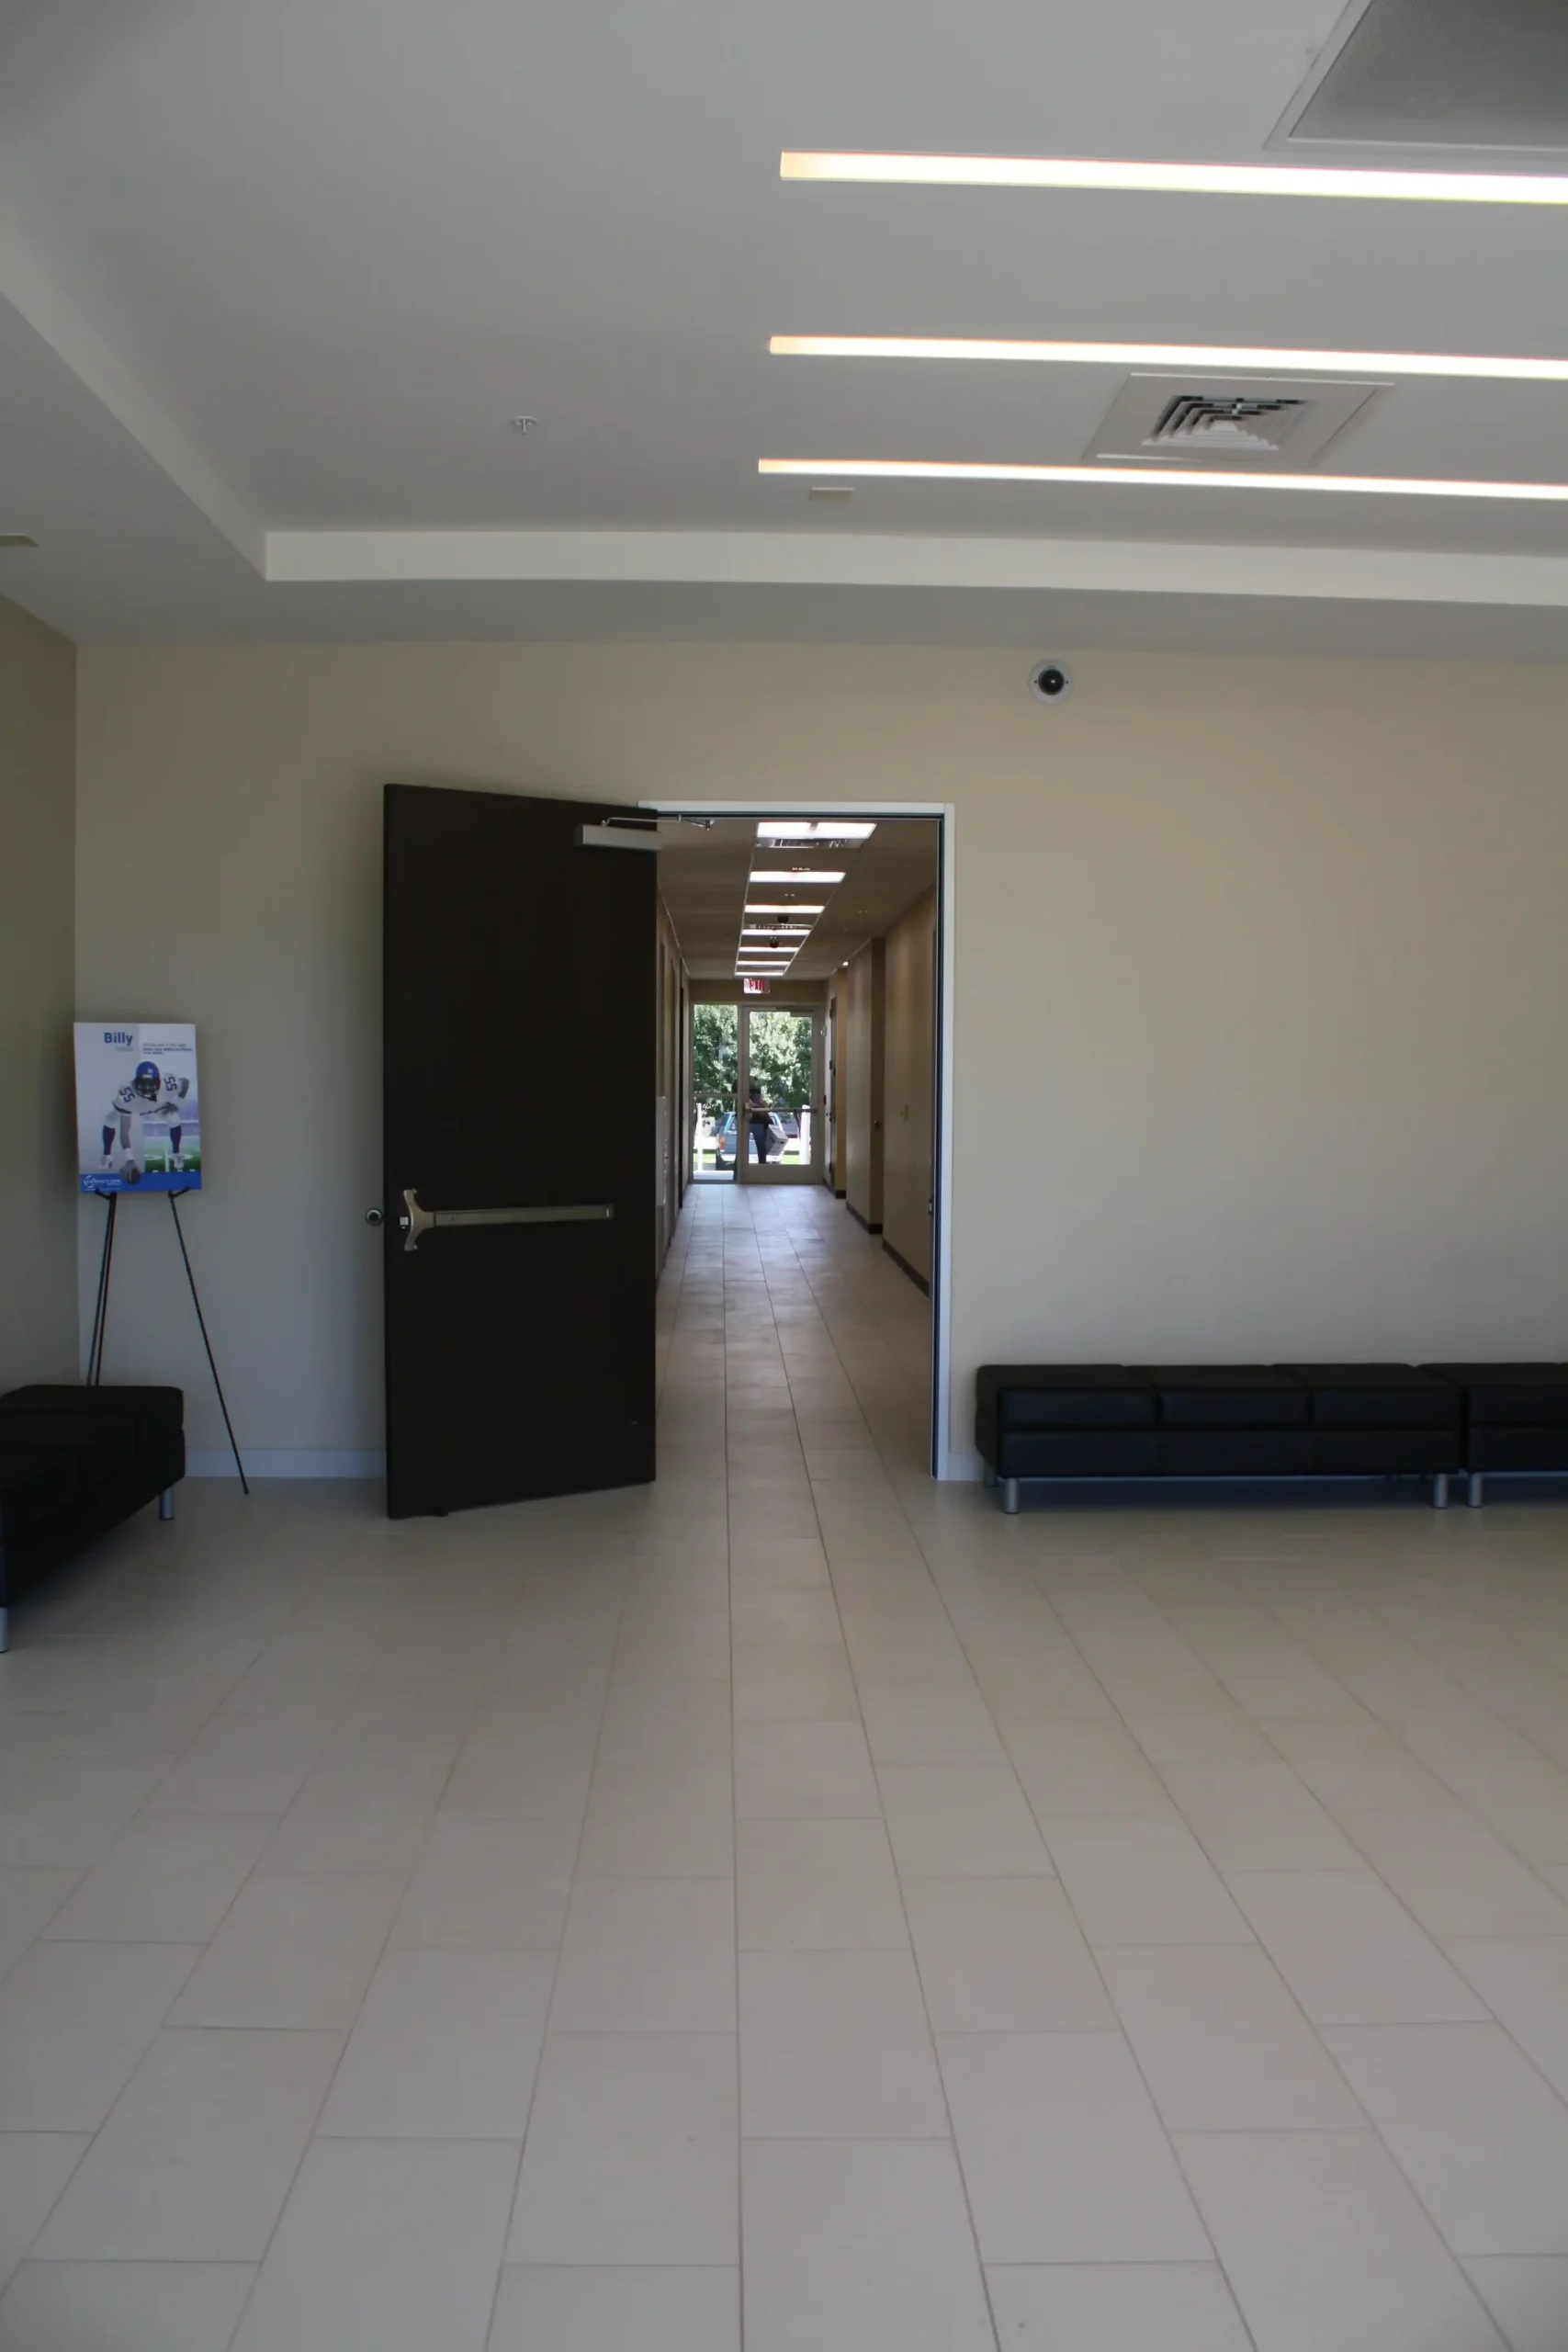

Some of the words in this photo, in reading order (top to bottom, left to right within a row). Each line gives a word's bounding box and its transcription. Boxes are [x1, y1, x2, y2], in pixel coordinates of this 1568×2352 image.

[749, 978, 766, 991] EXIT
[103, 1032, 133, 1046] Billy
[164, 1077, 177, 1091] 55
[119, 1087, 135, 1102] 55
